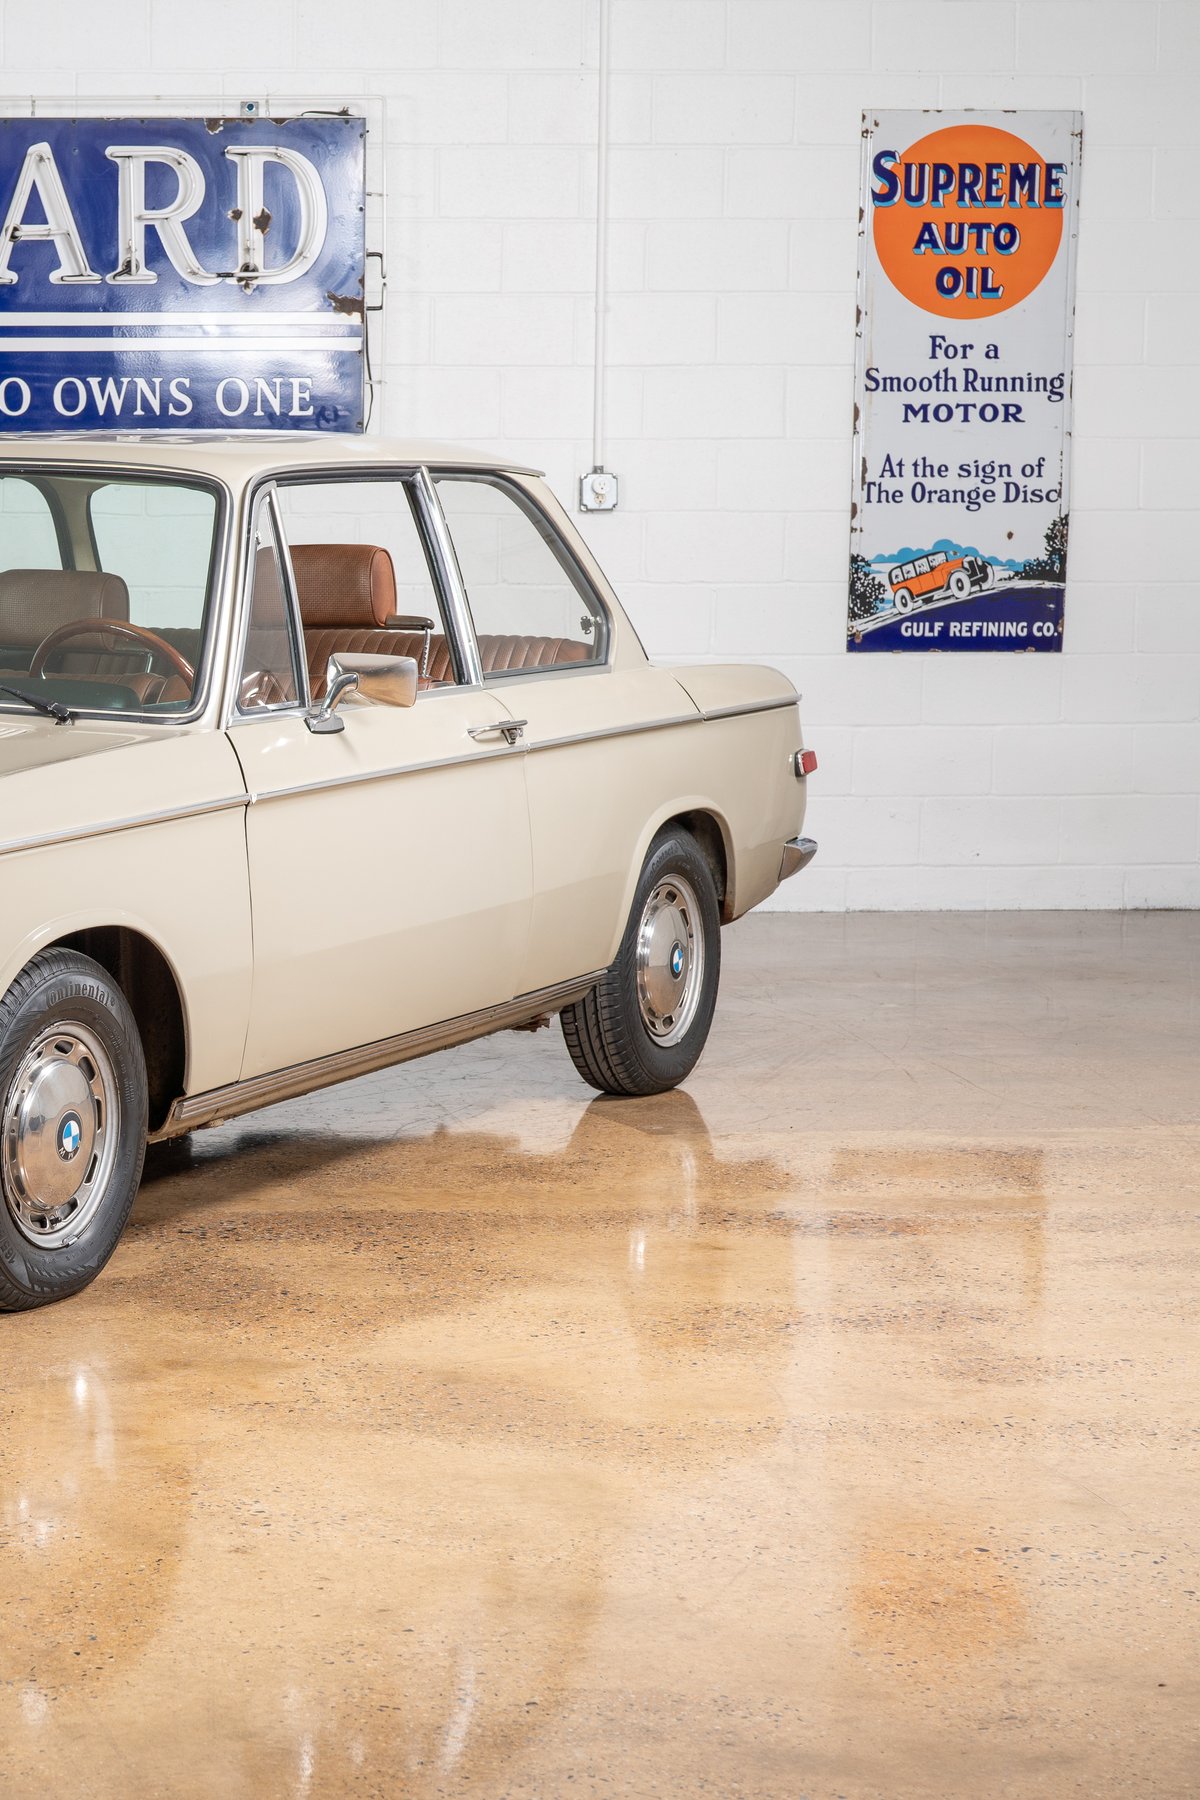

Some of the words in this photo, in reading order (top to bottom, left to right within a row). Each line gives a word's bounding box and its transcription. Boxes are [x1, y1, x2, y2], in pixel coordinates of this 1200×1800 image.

[871, 150, 1068, 208] SUPREME
[912, 222, 1021, 255] AUTO
[935, 266, 1005, 299] OIL
[928, 335, 975, 360] For
[984, 343, 1000, 360] a
[53, 376, 193, 417] OWNS
[215, 376, 315, 417] ONE
[864, 367, 958, 393] Smooth
[963, 368, 1065, 402] Running
[902, 403, 1026, 423] MOTOR
[879, 453, 905, 478] At
[912, 457, 949, 478] the
[957, 457, 1013, 484] sign
[1021, 457, 1046, 478] of
[864, 482, 903, 504] The
[910, 482, 996, 512] Orange
[1002, 482, 1060, 504] Disc
[900, 622, 945, 637] GULF
[949, 622, 1028, 637] REFINING
[1032, 622, 1059, 637] CO.
